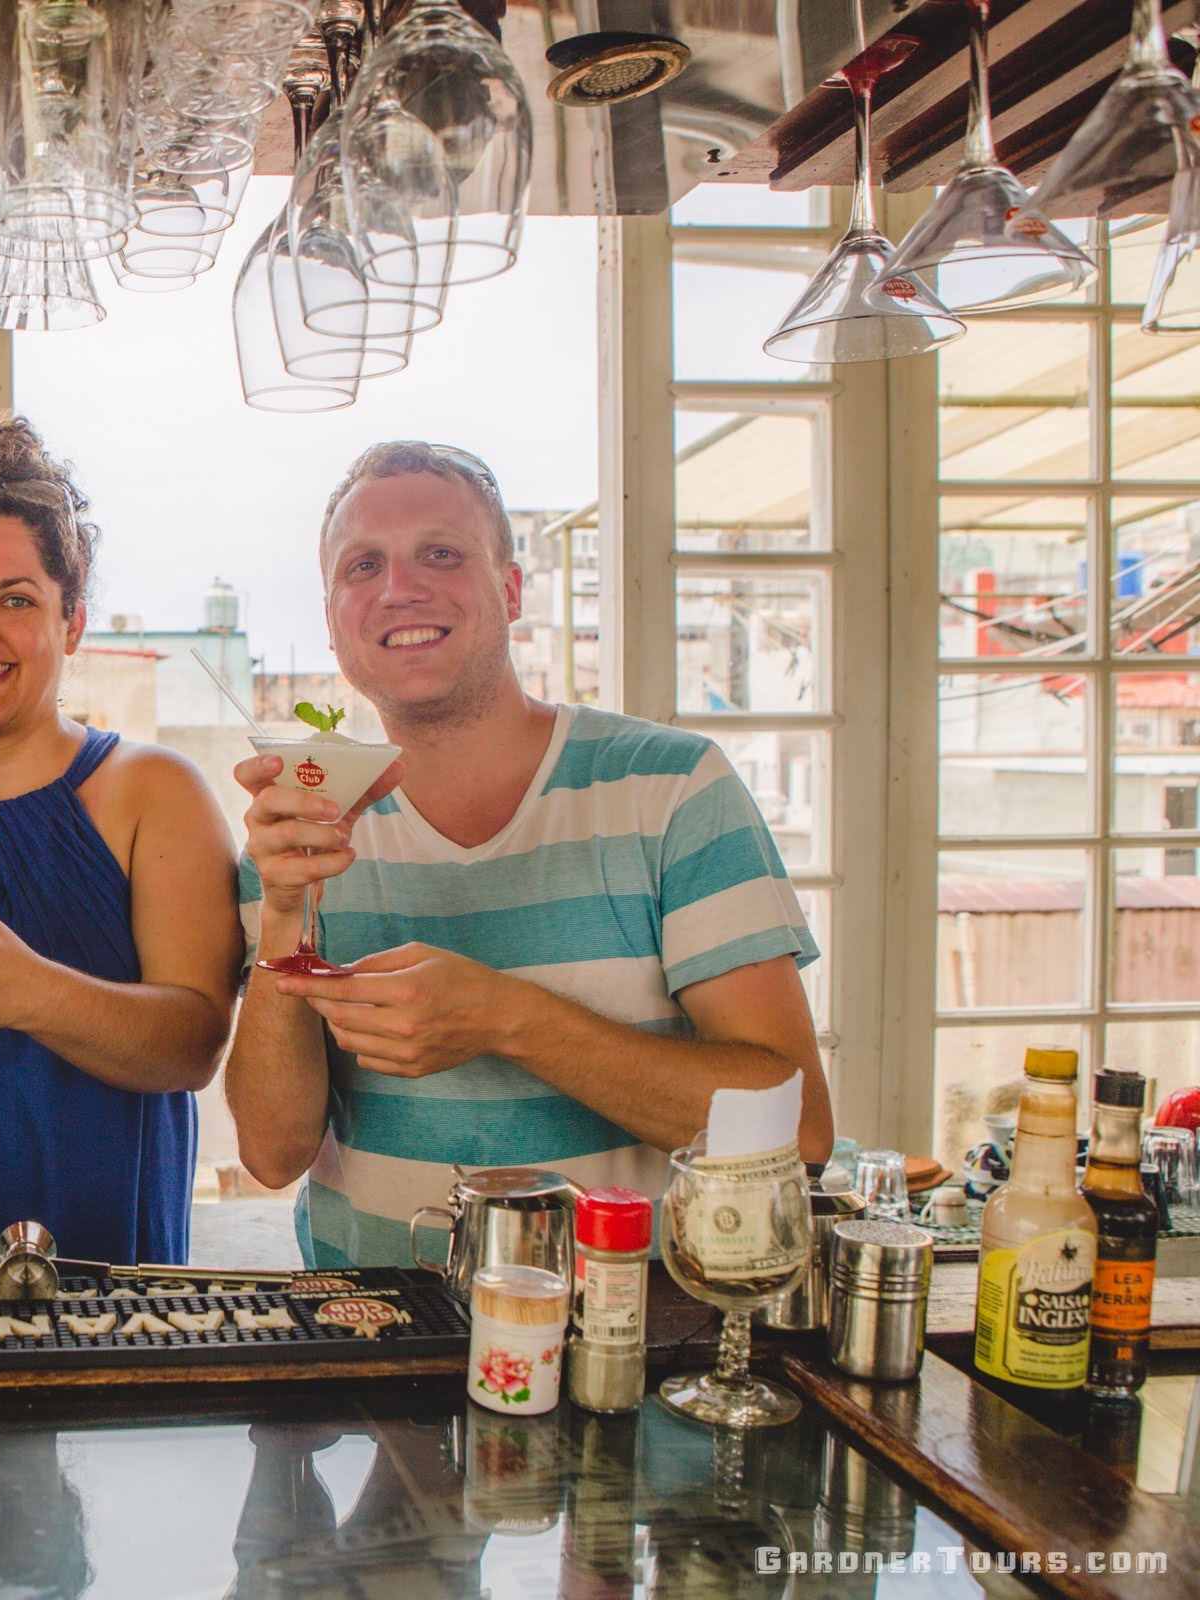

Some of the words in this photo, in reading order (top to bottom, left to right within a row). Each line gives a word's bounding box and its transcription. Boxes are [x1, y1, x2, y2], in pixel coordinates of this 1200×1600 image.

[299, 774, 321, 784] Club
[1113, 1273, 1142, 1285] LEA
[329, 1302, 383, 1313] Club
[314, 1309, 413, 1327] Havana
